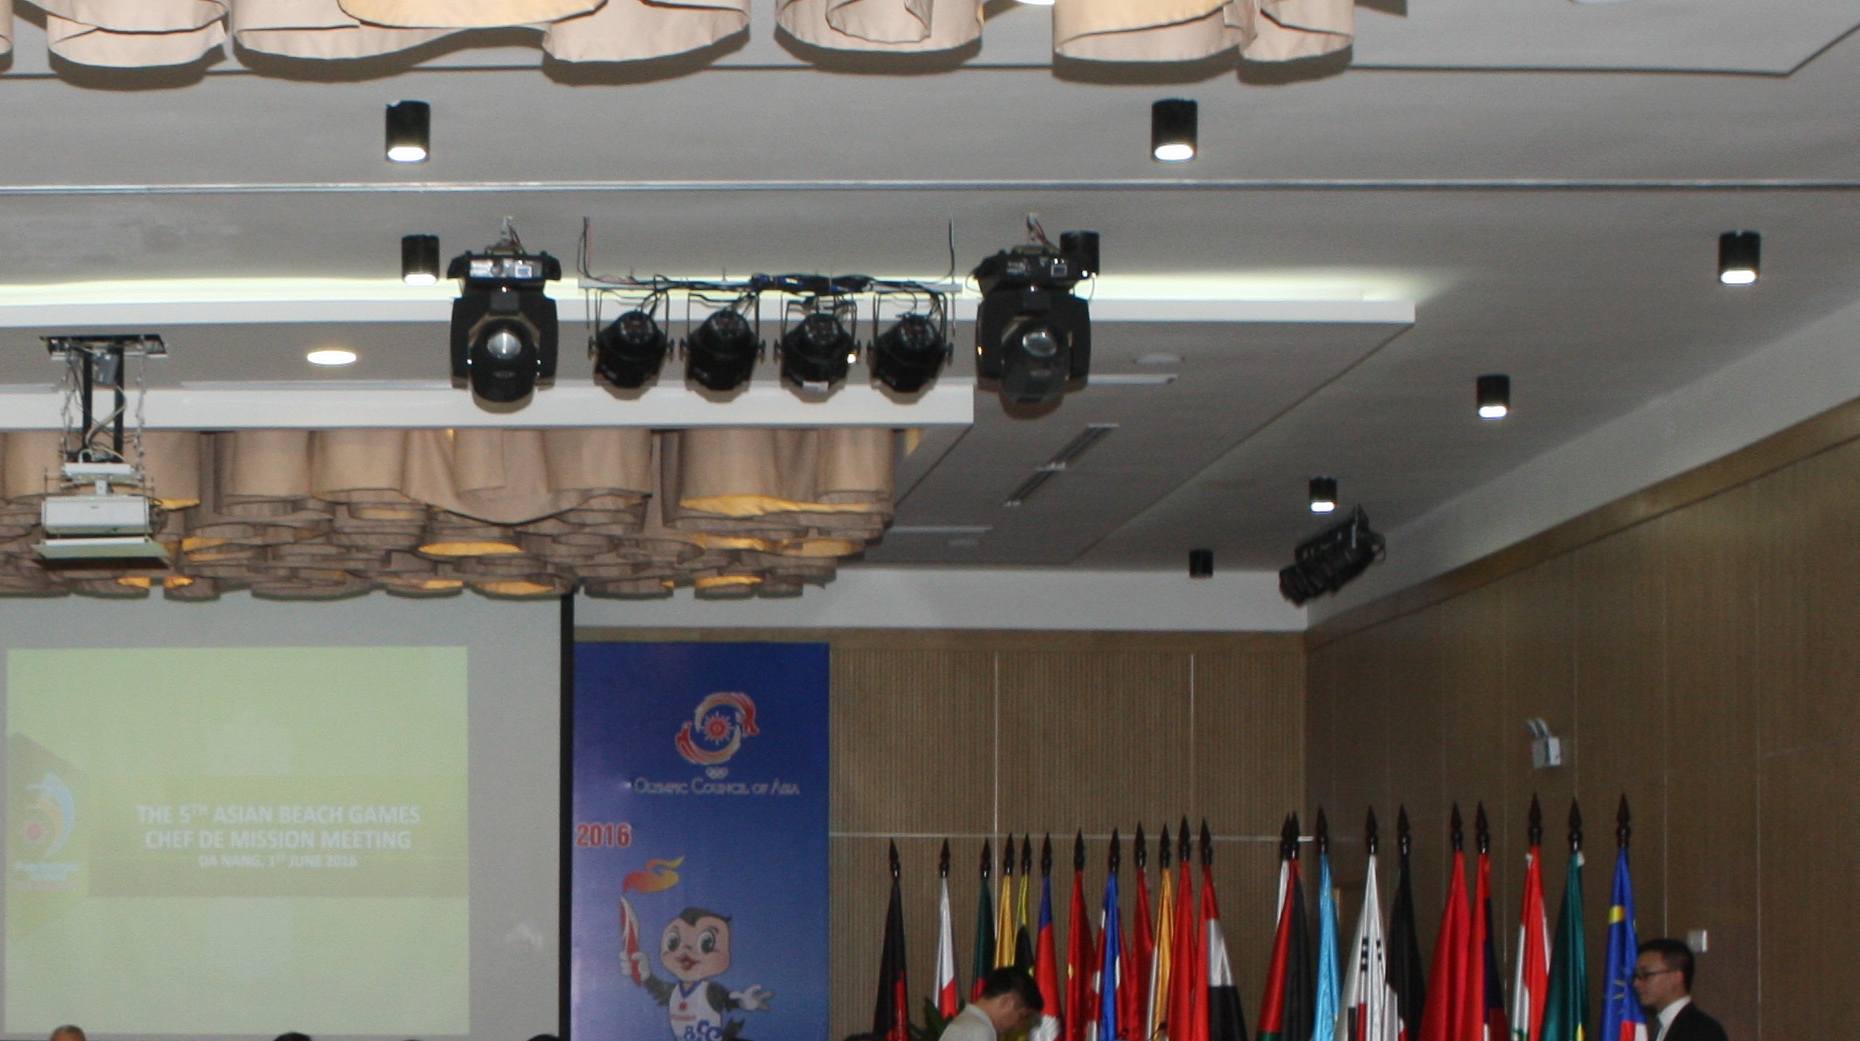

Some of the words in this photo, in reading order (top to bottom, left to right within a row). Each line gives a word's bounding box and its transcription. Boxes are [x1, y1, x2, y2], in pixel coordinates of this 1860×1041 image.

[692, 777, 750, 795] COUNCIL
[136, 804, 173, 824] THE
[212, 804, 273, 824] ASIAN
[279, 804, 343, 824] BEACH
[348, 804, 422, 825] GAMES
[145, 830, 194, 850] CHEF
[198, 830, 224, 850] DE
[230, 830, 315, 850] MISSION
[320, 830, 413, 850] MEETING
[575, 822, 633, 848] 2016
[289, 854, 322, 868] JUNE
